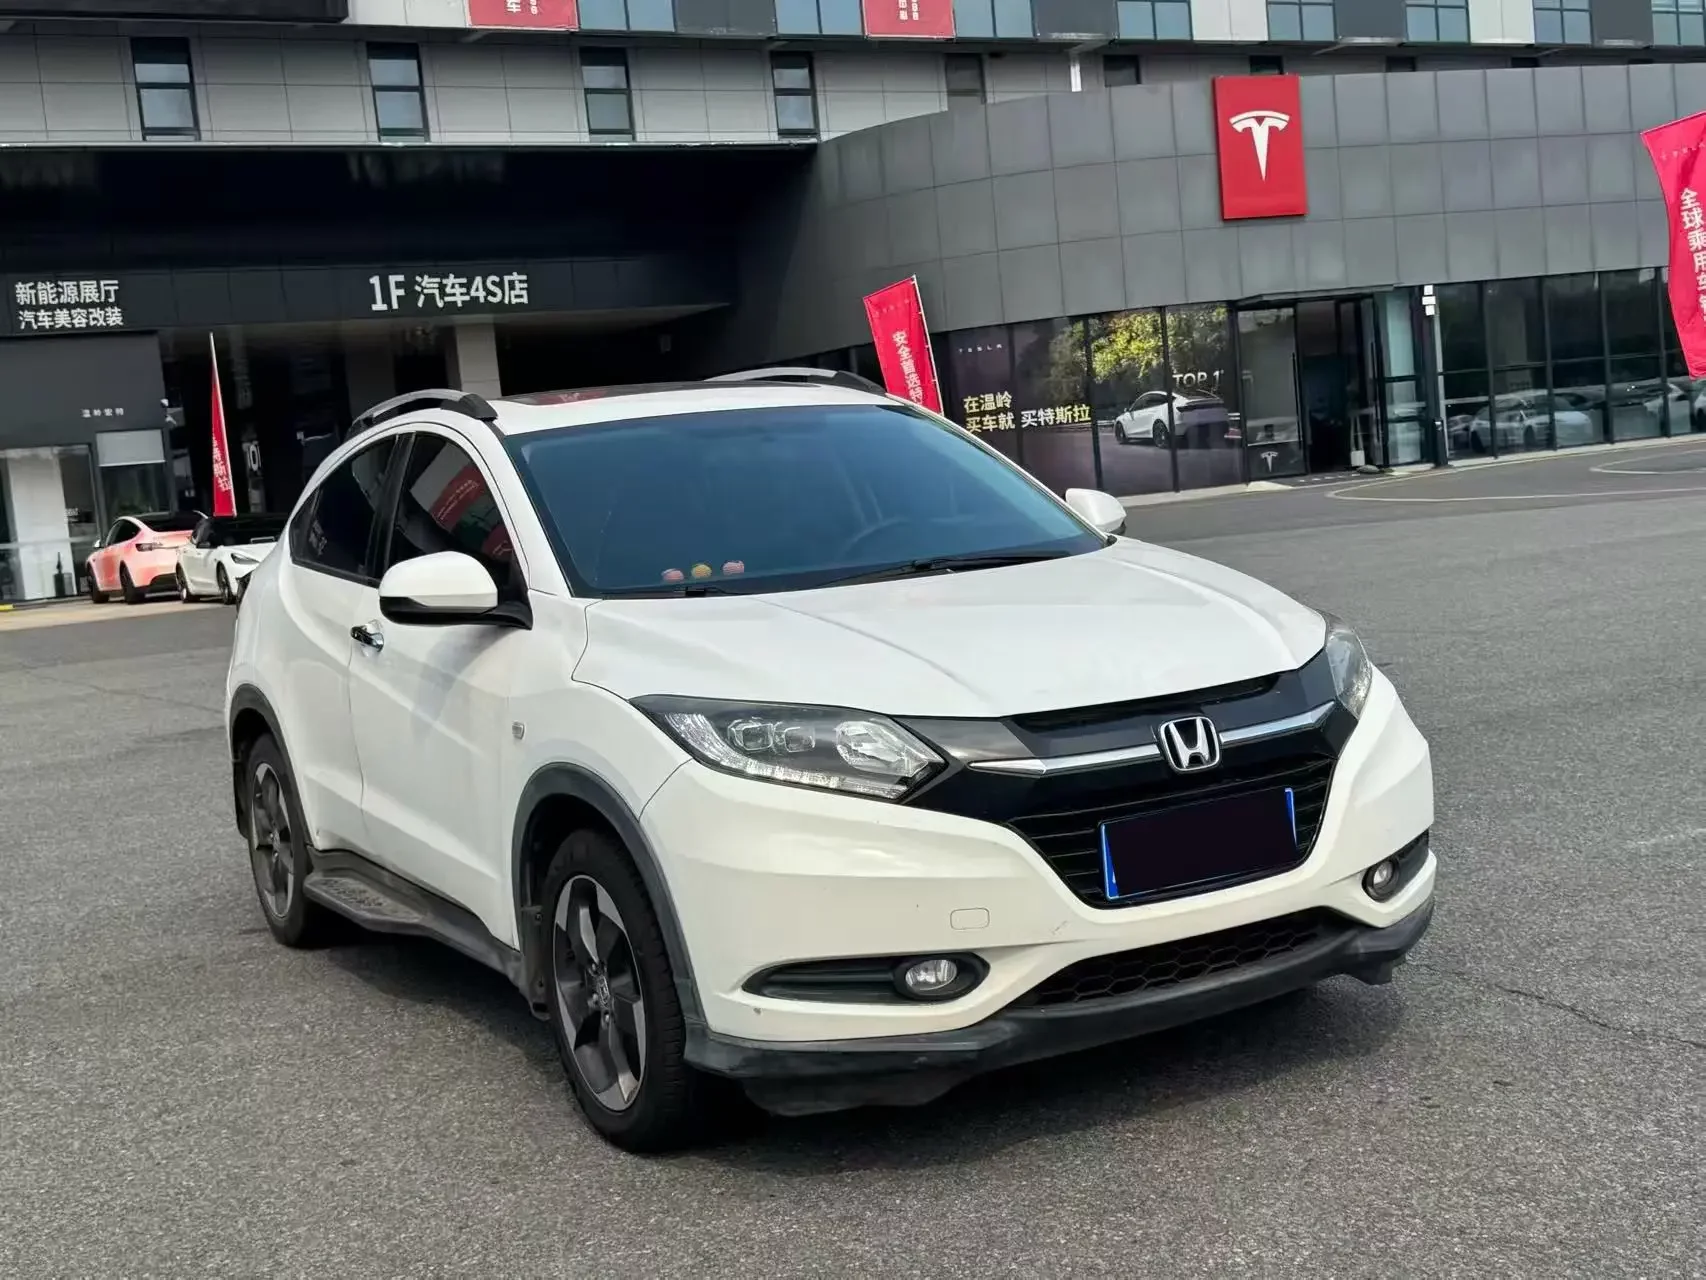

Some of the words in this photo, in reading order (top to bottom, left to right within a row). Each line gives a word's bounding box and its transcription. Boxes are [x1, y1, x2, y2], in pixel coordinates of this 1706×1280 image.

[15, 280, 119, 305] 新能源展厅
[369, 274, 405, 311] 1F
[414, 272, 528, 308] 汽车4S店
[18, 306, 124, 330] 汽车美容改装
[1172, 371, 1207, 388] TOP
[963, 391, 1012, 413] 在温岭
[965, 412, 1016, 433] 买车就
[1020, 404, 1091, 428] 买特斯拉
